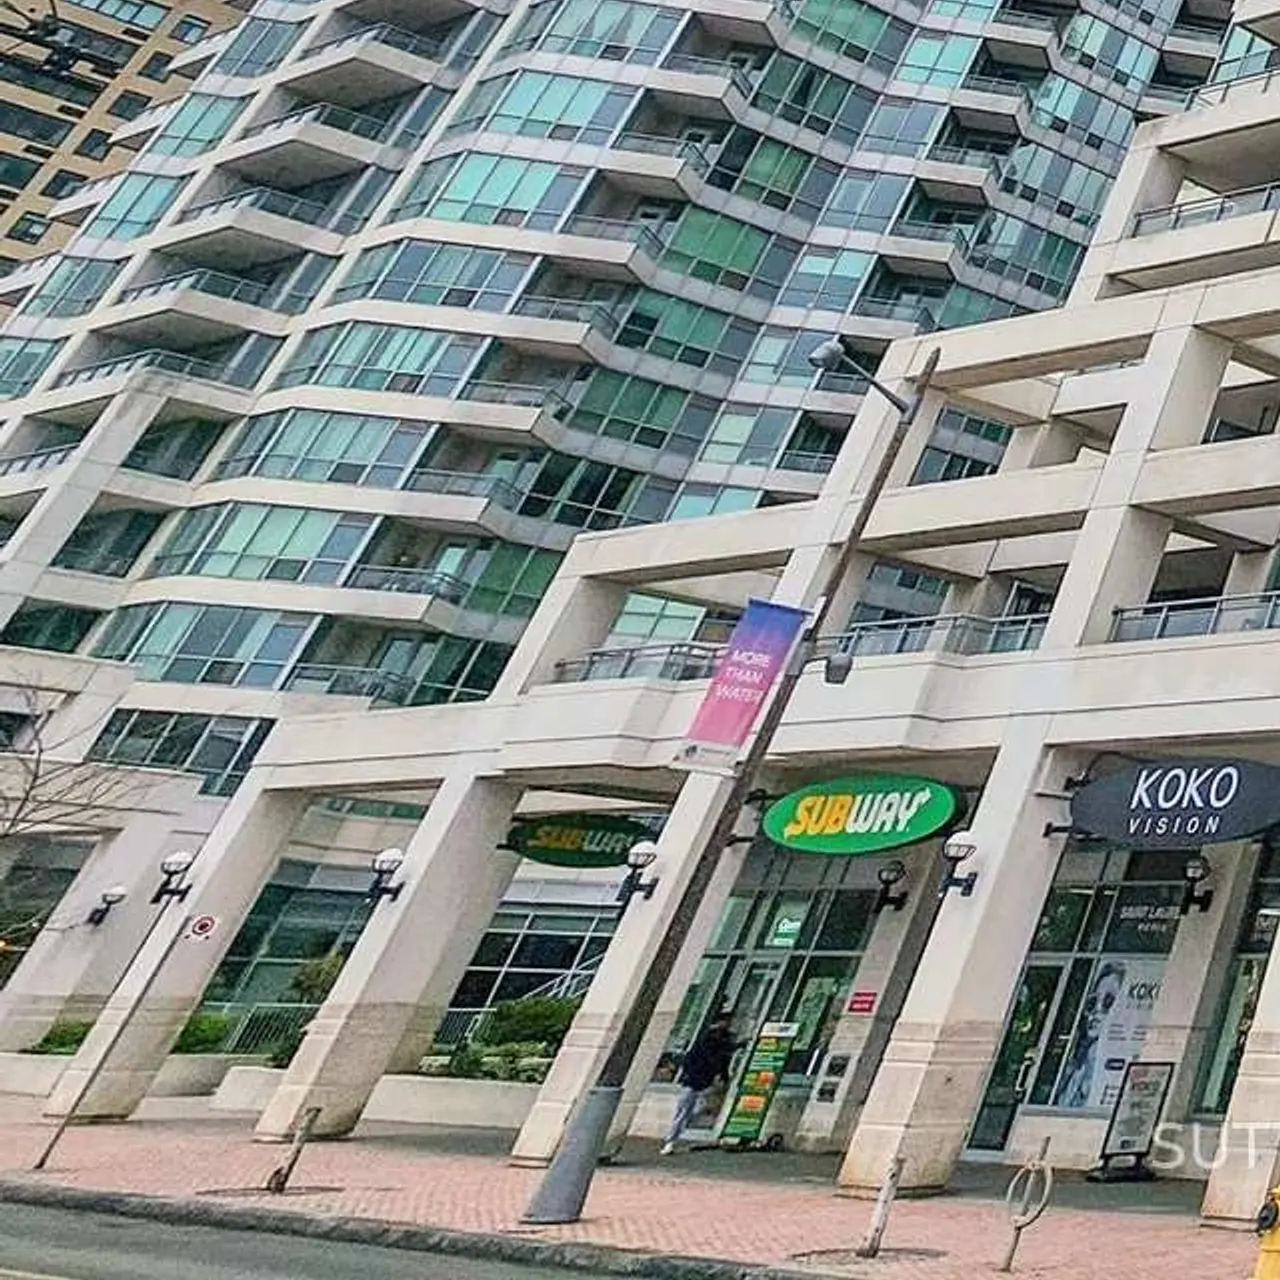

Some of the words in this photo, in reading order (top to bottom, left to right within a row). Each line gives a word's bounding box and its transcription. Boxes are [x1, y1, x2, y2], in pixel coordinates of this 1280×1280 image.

[1130, 766, 1239, 810] KOKO
[784, 787, 932, 841] SUBWAY
[1128, 816, 1220, 835] VISION
[1128, 982, 1160, 1000] KOK
